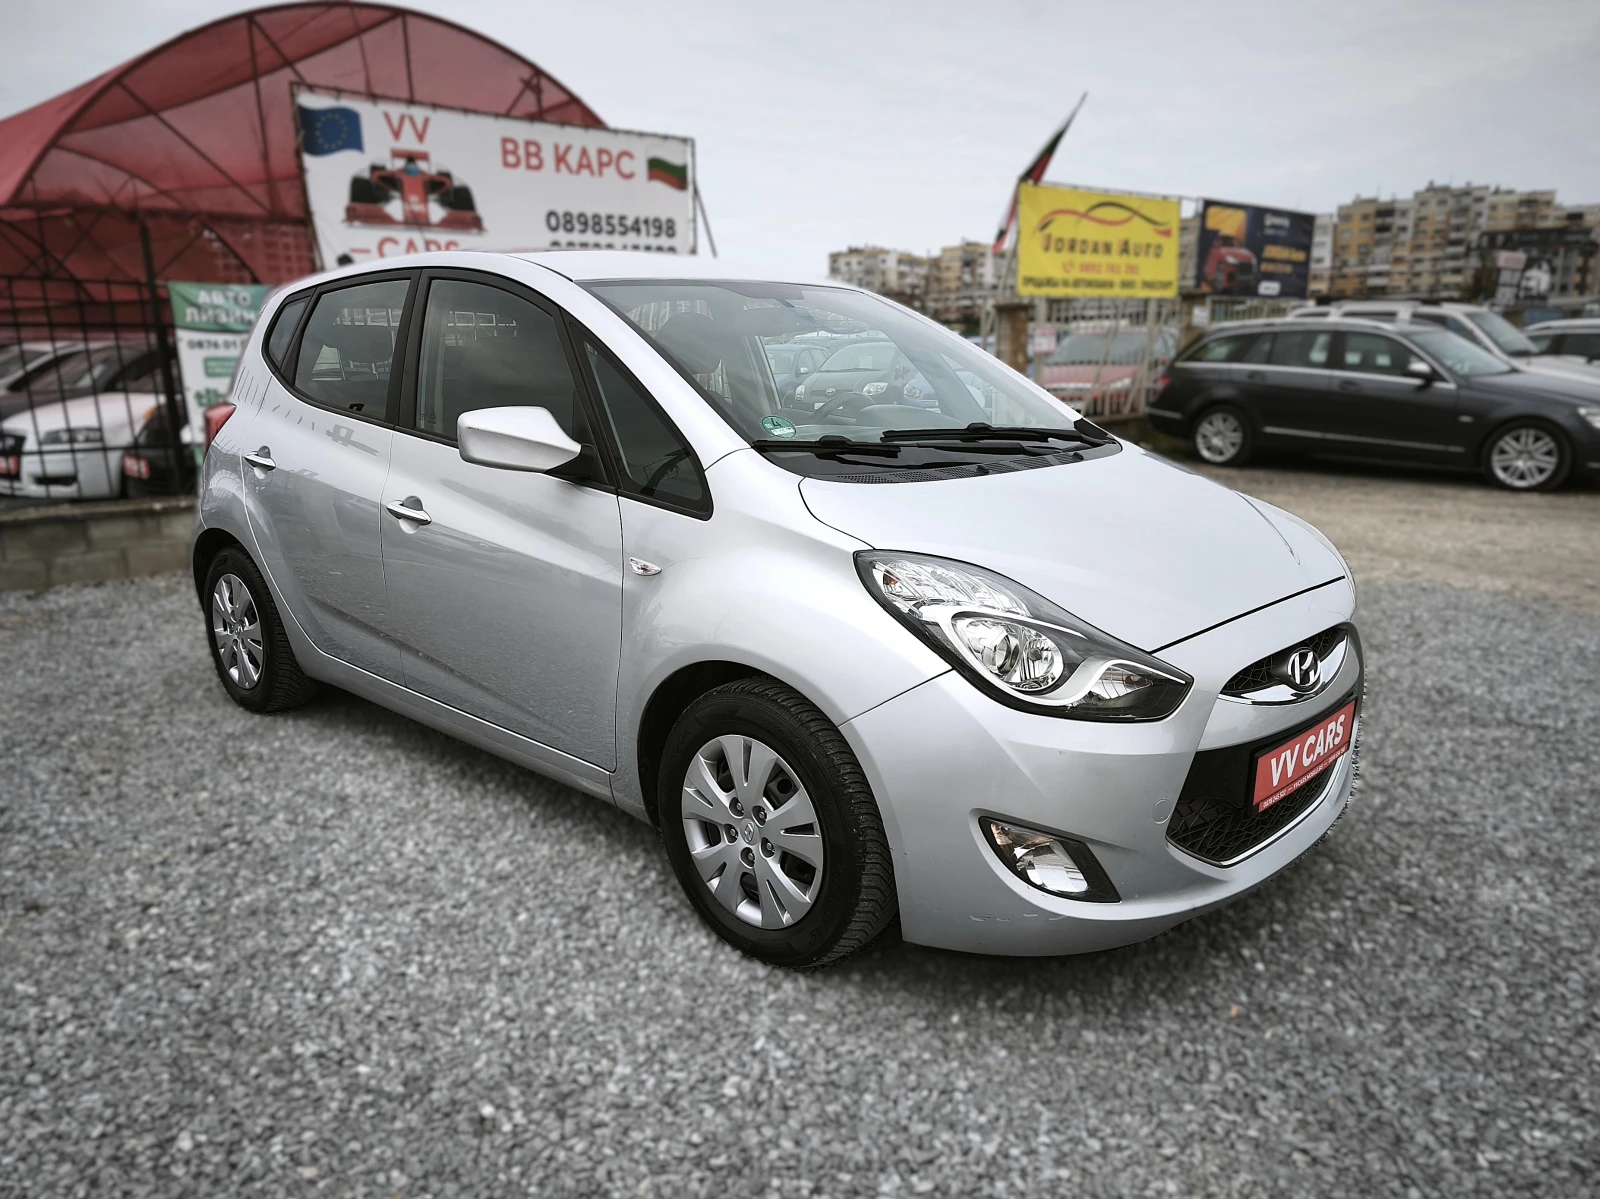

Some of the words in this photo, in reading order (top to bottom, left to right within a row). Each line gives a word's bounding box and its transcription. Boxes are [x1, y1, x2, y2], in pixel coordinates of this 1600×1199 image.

[383, 111, 431, 145] VV
[500, 136, 544, 172] ВВ
[553, 142, 637, 181] КАРС
[545, 209, 677, 239] 0898554198
[198, 289, 252, 308] АВТО
[185, 306, 260, 324] ЛИЗИН
[1270, 743, 1301, 788] VV
[1302, 714, 1346, 767] CARS
